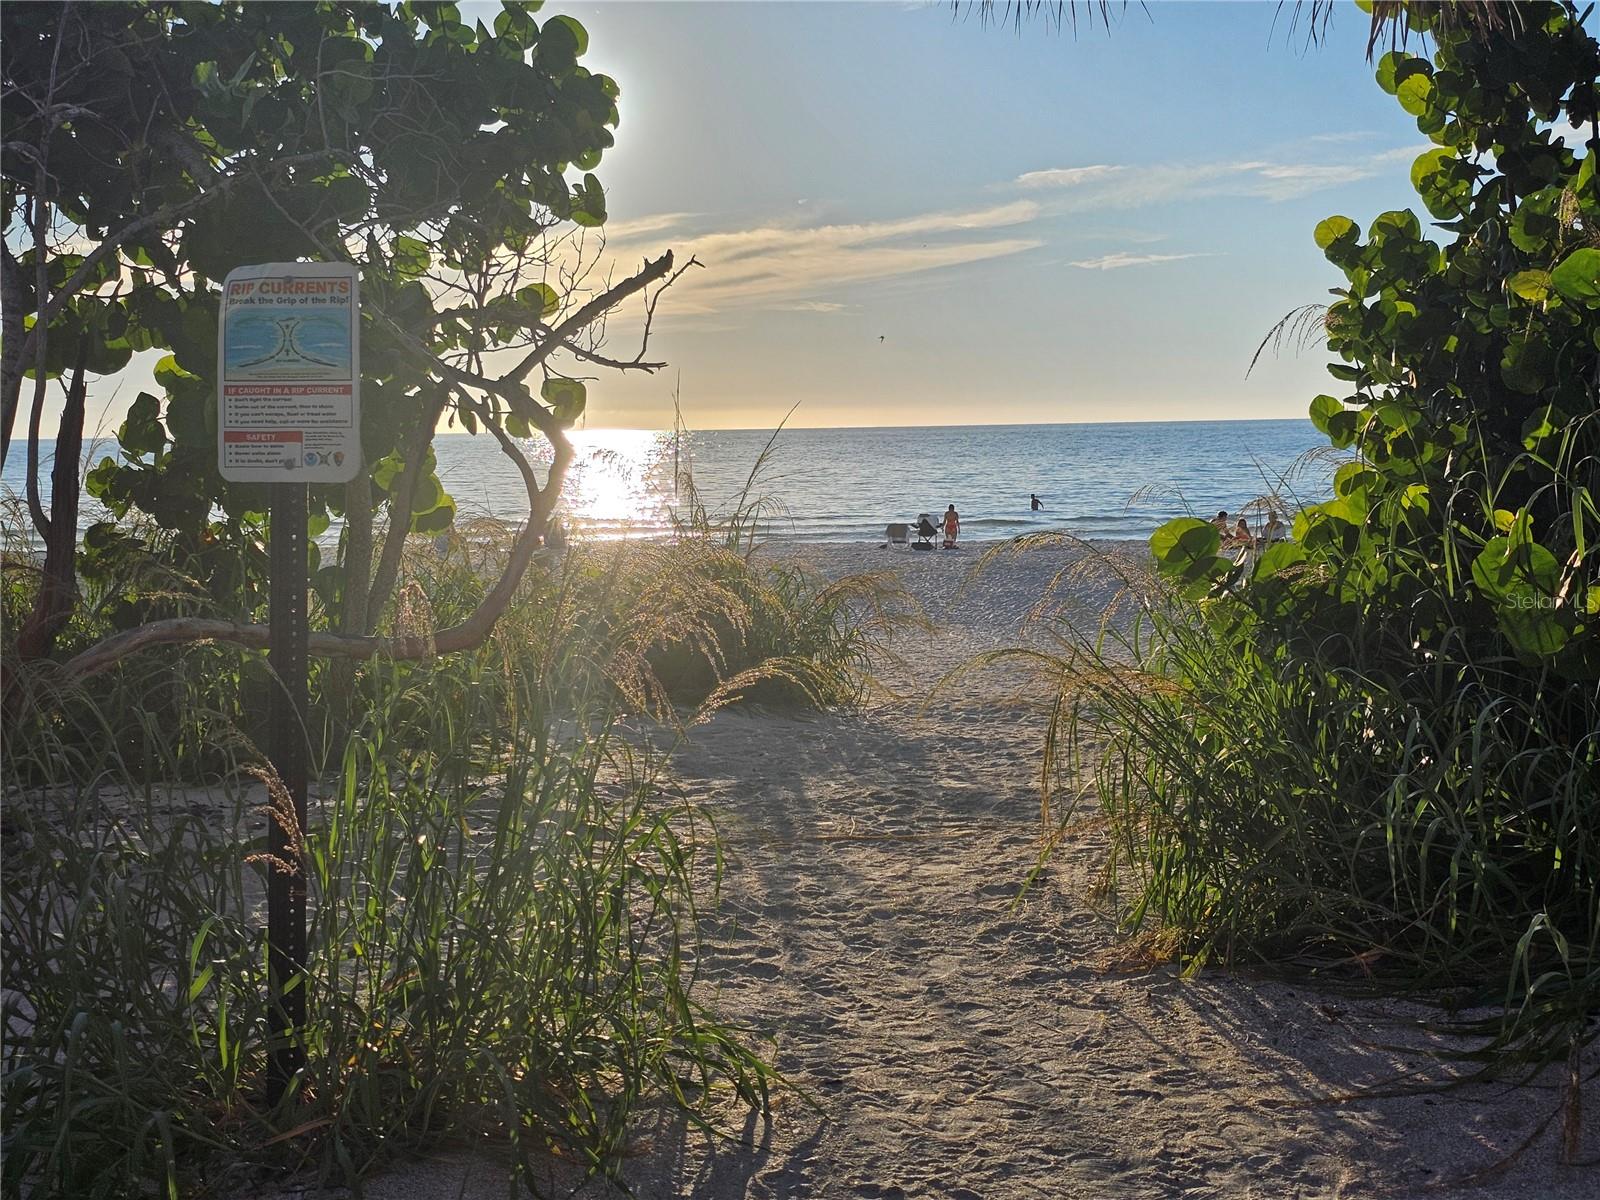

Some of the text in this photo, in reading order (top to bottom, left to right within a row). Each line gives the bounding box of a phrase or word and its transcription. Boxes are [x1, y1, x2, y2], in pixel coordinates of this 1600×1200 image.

[230, 281, 349, 295] RIP CURRENTS
[276, 296, 297, 306] Grip
[299, 296, 308, 304] of
[312, 296, 329, 304] the
[330, 295, 349, 305] Rip!
[246, 433, 276, 441] SAFETY
